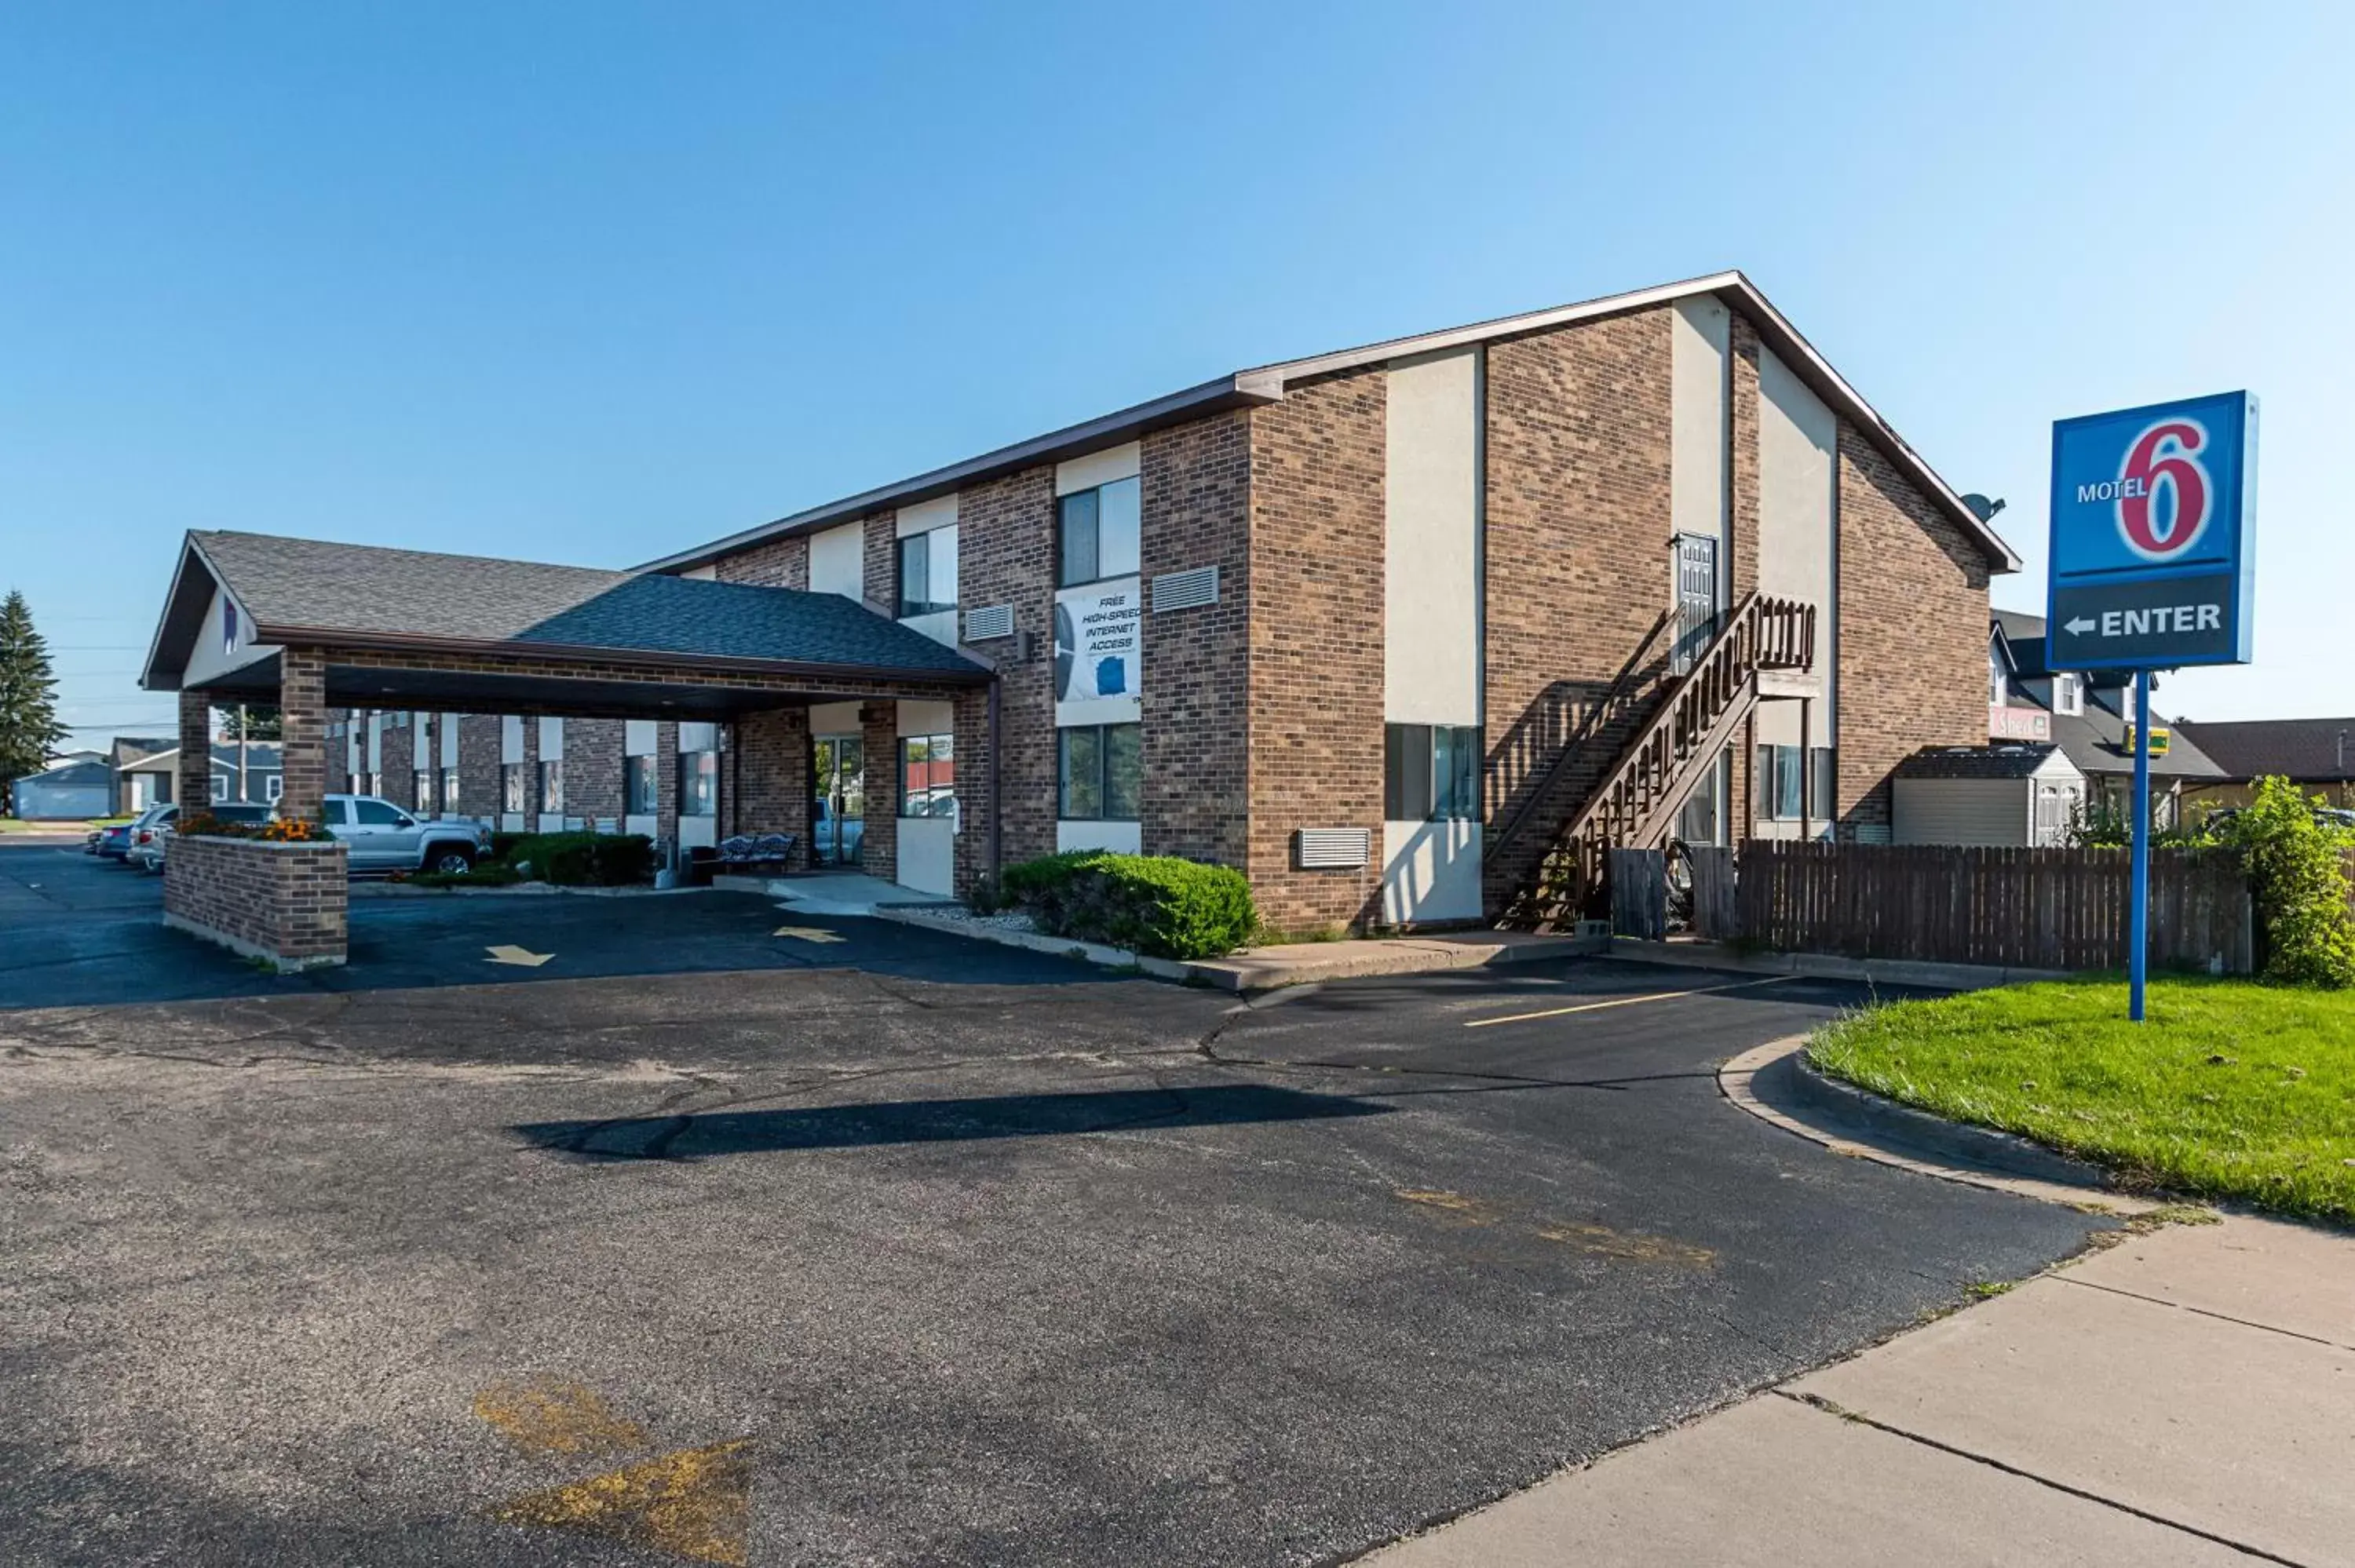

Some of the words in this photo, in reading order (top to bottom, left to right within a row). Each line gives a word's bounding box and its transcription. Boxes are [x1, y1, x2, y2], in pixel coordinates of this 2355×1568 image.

[2077, 477, 2147, 502] MOTEL
[2117, 418, 2211, 560] 6
[1099, 596, 1126, 607] FREE
[2101, 603, 2221, 636] ENTER
[1086, 623, 1136, 636] INTERNET
[1089, 638, 1132, 651] ACCESS
